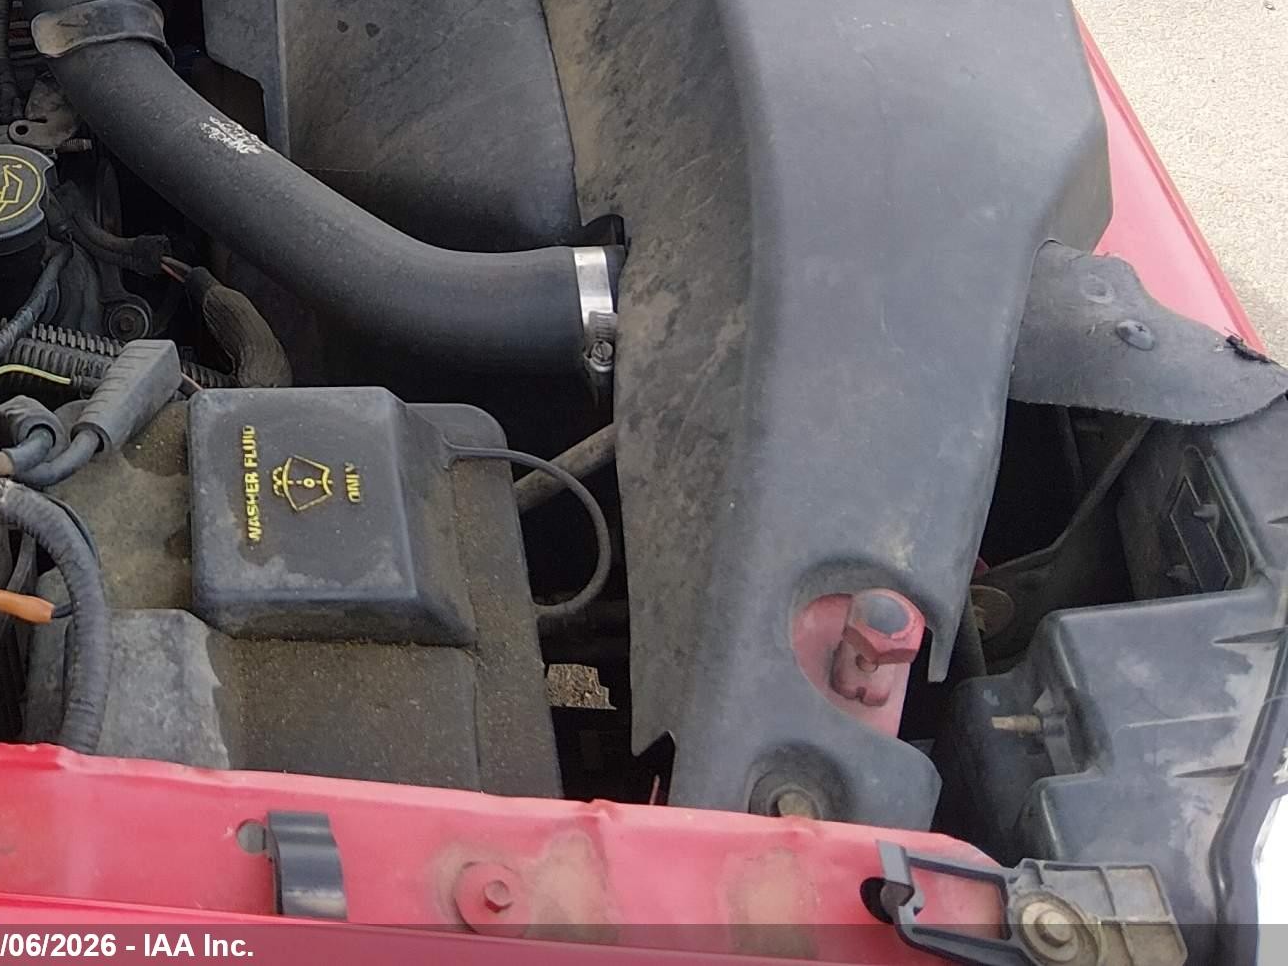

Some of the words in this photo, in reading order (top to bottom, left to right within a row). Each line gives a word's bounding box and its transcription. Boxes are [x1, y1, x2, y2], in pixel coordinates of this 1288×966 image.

[242, 425, 257, 467] FLUID
[345, 462, 360, 503] ONLY
[245, 472, 262, 542] WASHER
